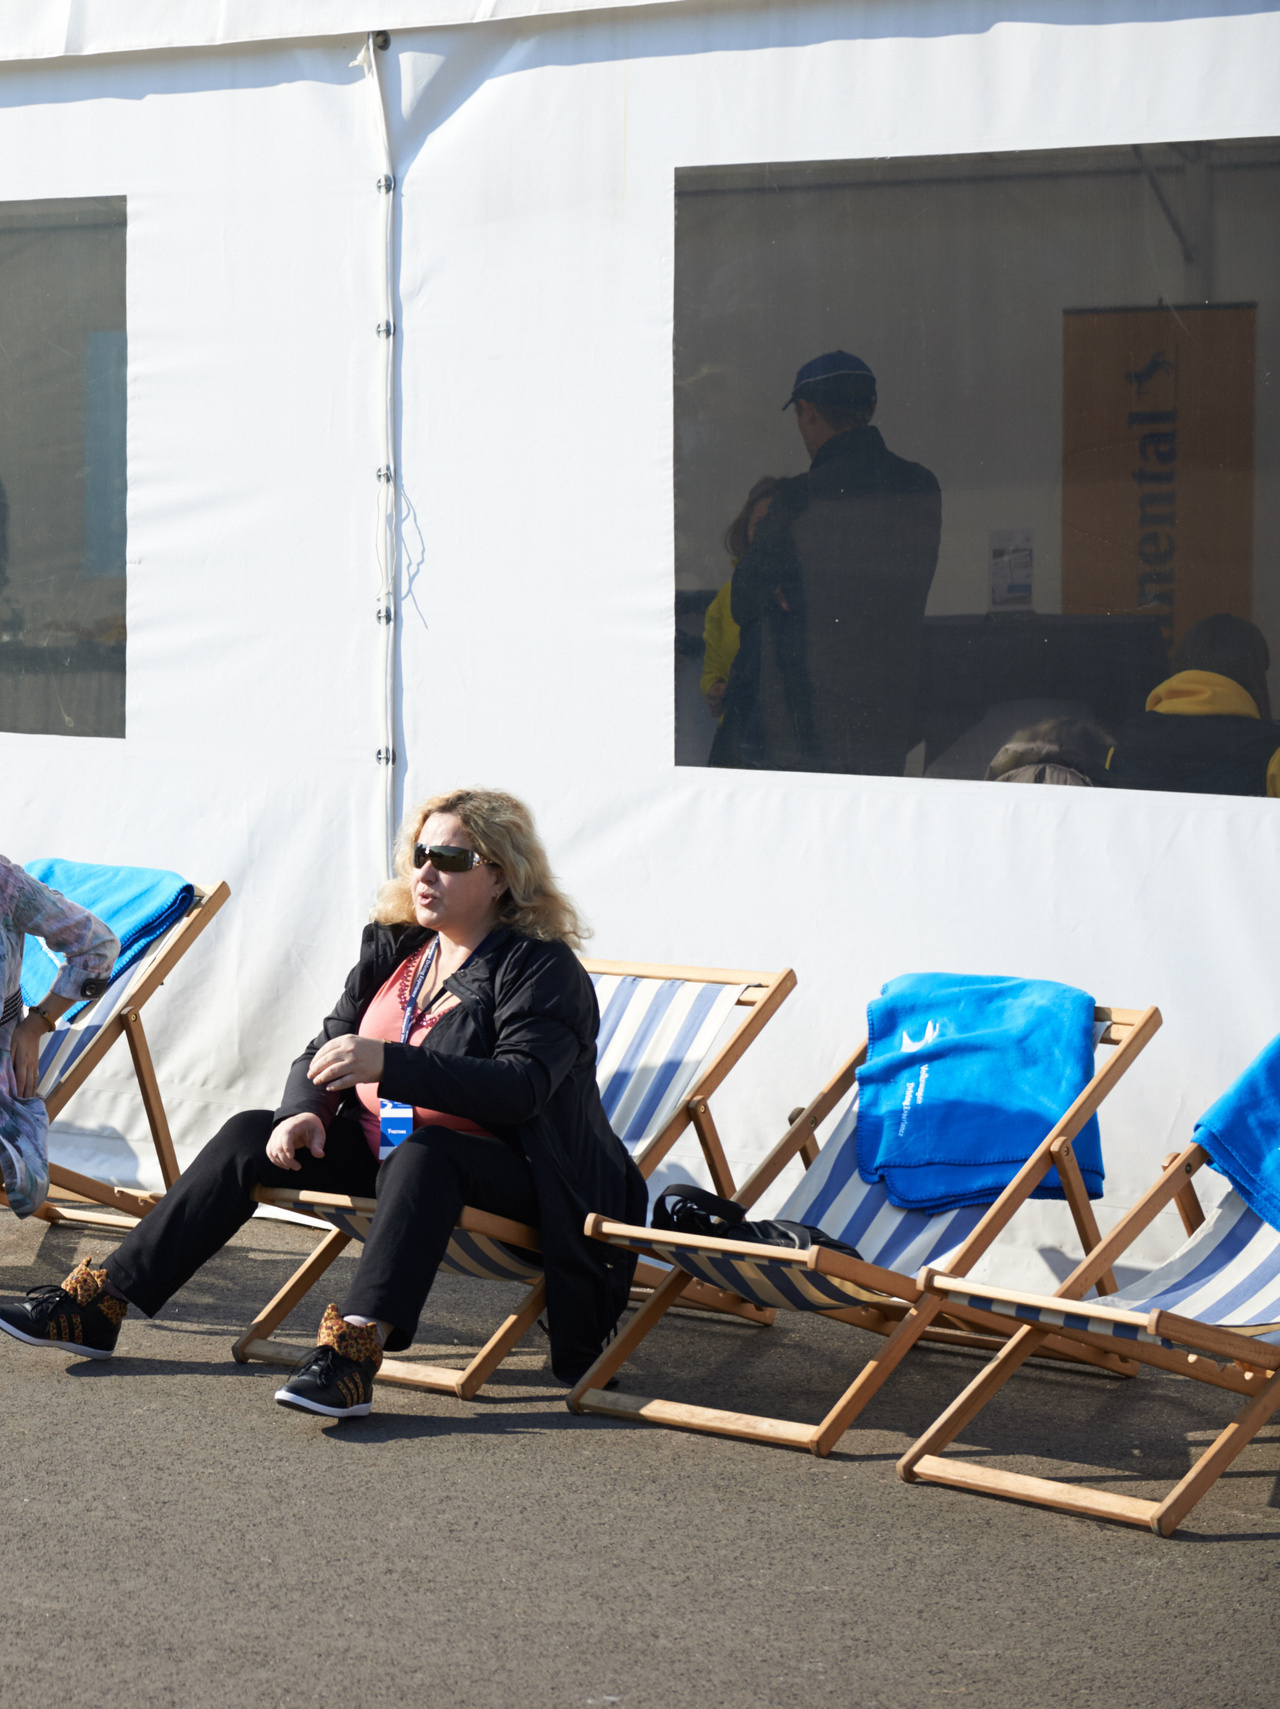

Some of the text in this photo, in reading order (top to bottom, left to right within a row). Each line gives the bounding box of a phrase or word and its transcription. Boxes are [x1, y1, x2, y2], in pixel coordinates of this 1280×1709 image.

[1127, 406, 1178, 632] nental
[902, 1082, 915, 1106] Driving
[915, 1064, 929, 1104] Volkswagen
